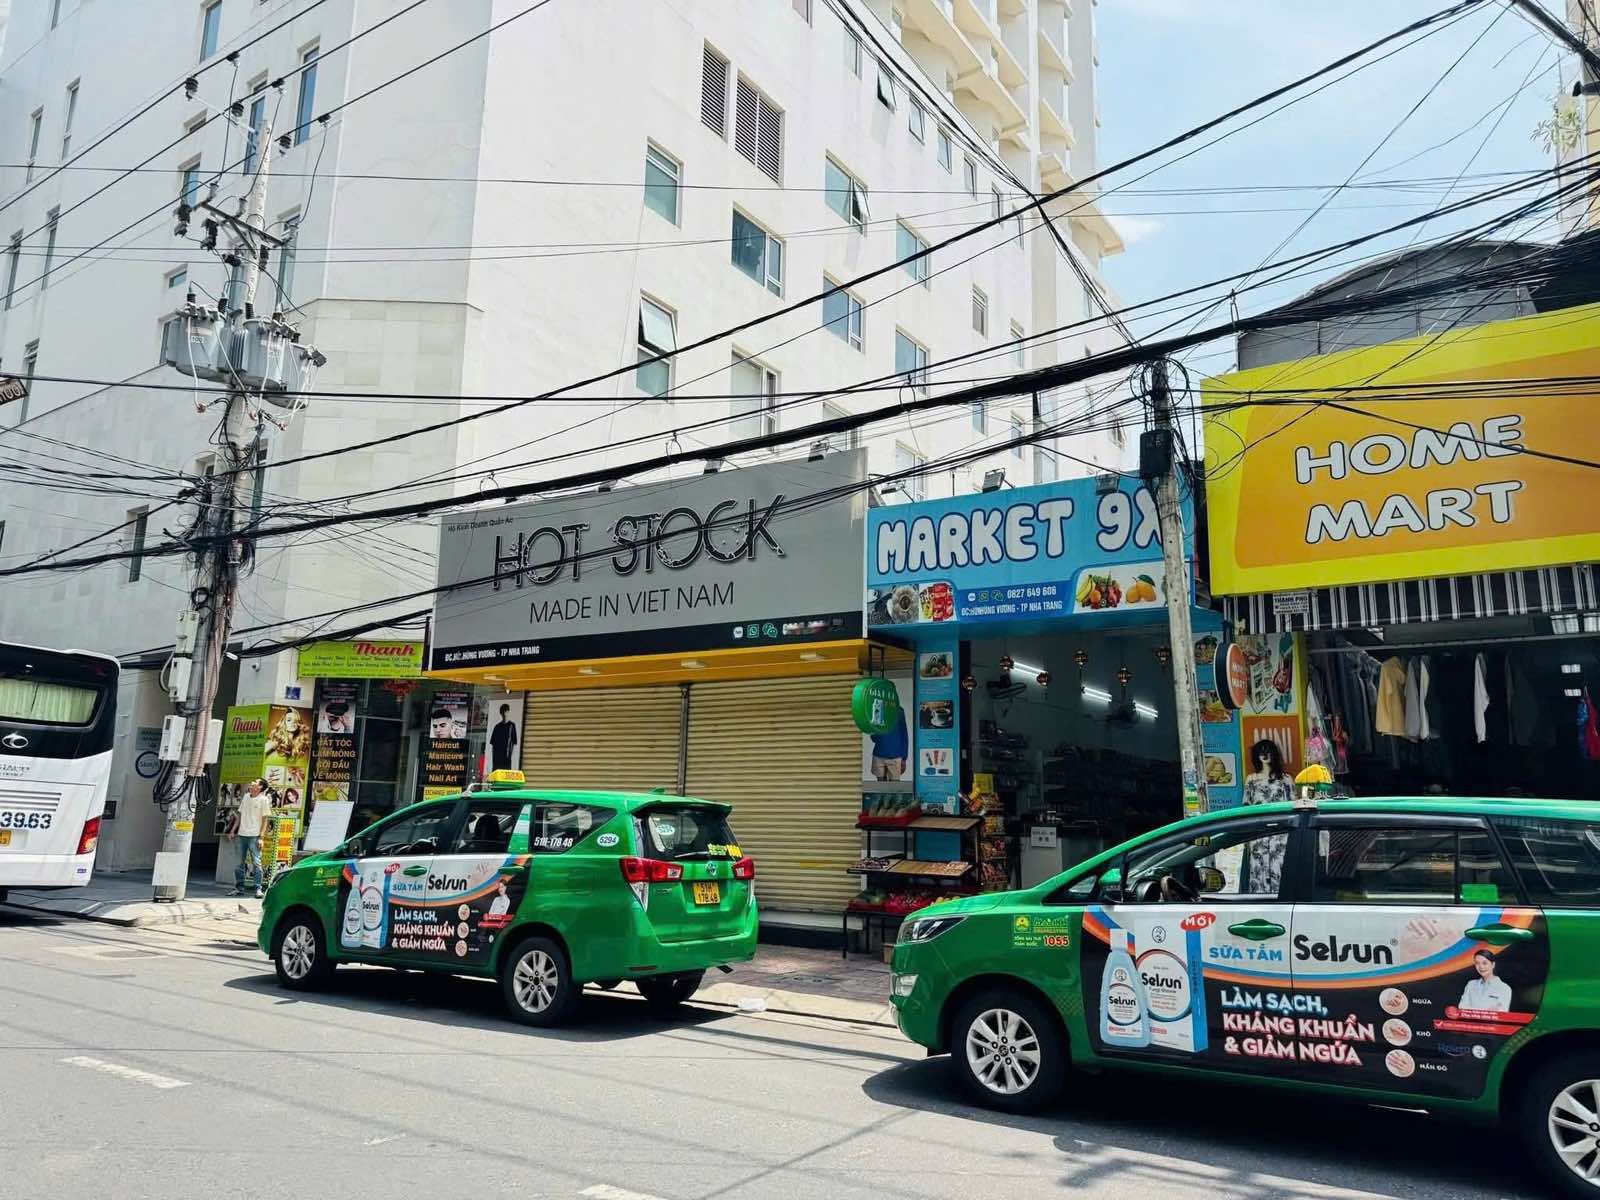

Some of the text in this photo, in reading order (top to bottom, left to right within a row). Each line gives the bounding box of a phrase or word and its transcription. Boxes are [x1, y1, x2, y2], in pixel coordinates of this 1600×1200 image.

[1294, 414, 1525, 485] HOME
[1305, 480, 1523, 545] MART
[492, 493, 787, 590] HOT STOCK
[876, 497, 1075, 575] MARKET
[1007, 588, 1024, 599] 0827
[1026, 587, 1040, 597] 649
[529, 582, 735, 624] MADE IN VIET NAM
[996, 603, 1016, 614] VƯƠNG
[1020, 603, 1028, 612] TP
[1029, 602, 1042, 612] NHA
[1043, 600, 1063, 610] TRANG
[353, 642, 416, 656] Thanh
[478, 649, 496, 658] VƯƠNG
[500, 648, 508, 656] TP
[508, 647, 520, 656] NHA
[522, 646, 540, 655] TRANG
[232, 716, 263, 733] Thanh
[432, 741, 460, 749] Haircut
[428, 752, 464, 760] Manicure
[426, 763, 464, 771] Hair Wash
[428, 774, 457, 782] Nail Art
[428, 874, 468, 891] Selsun
[394, 907, 438, 922] LÀM SẠCH,
[1186, 916, 1213, 927] MỚI
[394, 922, 424, 936] KHÁNG
[392, 940, 398, 949] &
[422, 938, 446, 951] NGỨA
[1043, 935, 1070, 947] 1055
[1209, 943, 1282, 961] SỮA TẮM
[1294, 934, 1393, 964] Selsun
[1142, 972, 1182, 989] Selsun
[1108, 996, 1136, 1006] Selsun
[1220, 987, 1328, 1016] LÀM SẠCH,
[1222, 1010, 1376, 1042] KHÁNG KHUẨN
[1224, 1036, 1363, 1066] & GIẢM NGỨA
